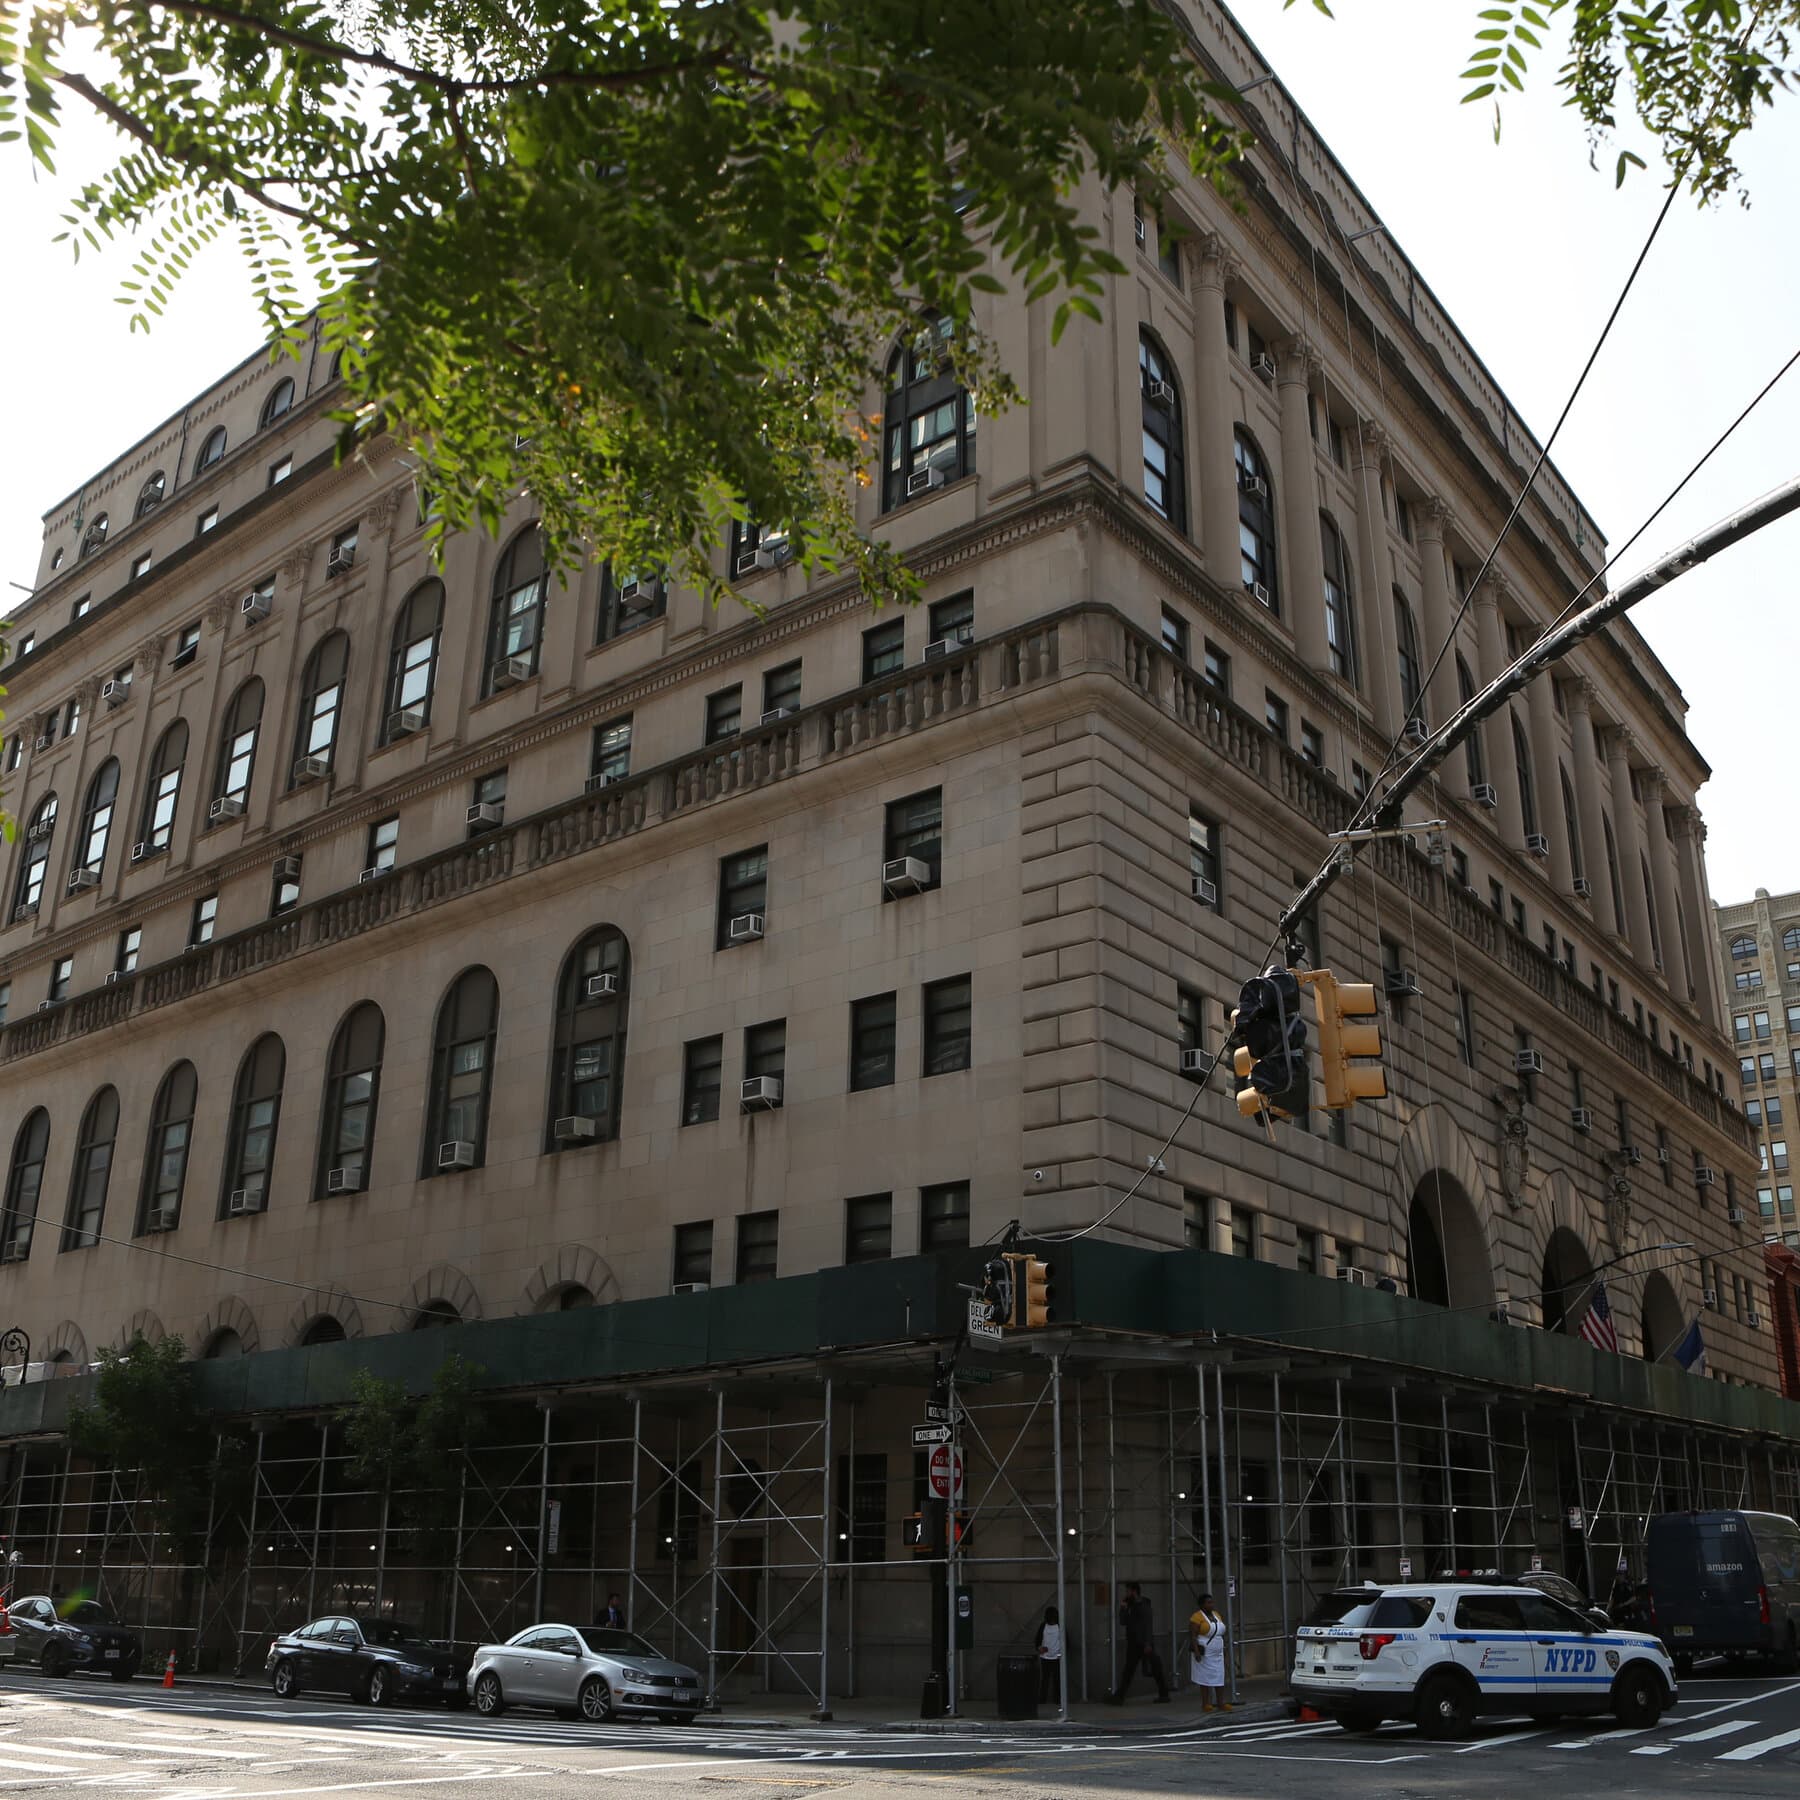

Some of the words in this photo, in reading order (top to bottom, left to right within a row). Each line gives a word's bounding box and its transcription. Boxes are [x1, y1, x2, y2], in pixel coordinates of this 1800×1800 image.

[971, 1319, 1000, 1335] GREEN
[918, 1431, 932, 1440] ONE
[936, 1429, 948, 1438] WAY
[935, 1455, 944, 1464] DO
[1706, 1562, 1743, 1571] amazon
[1544, 1649, 1597, 1673] NYPD
